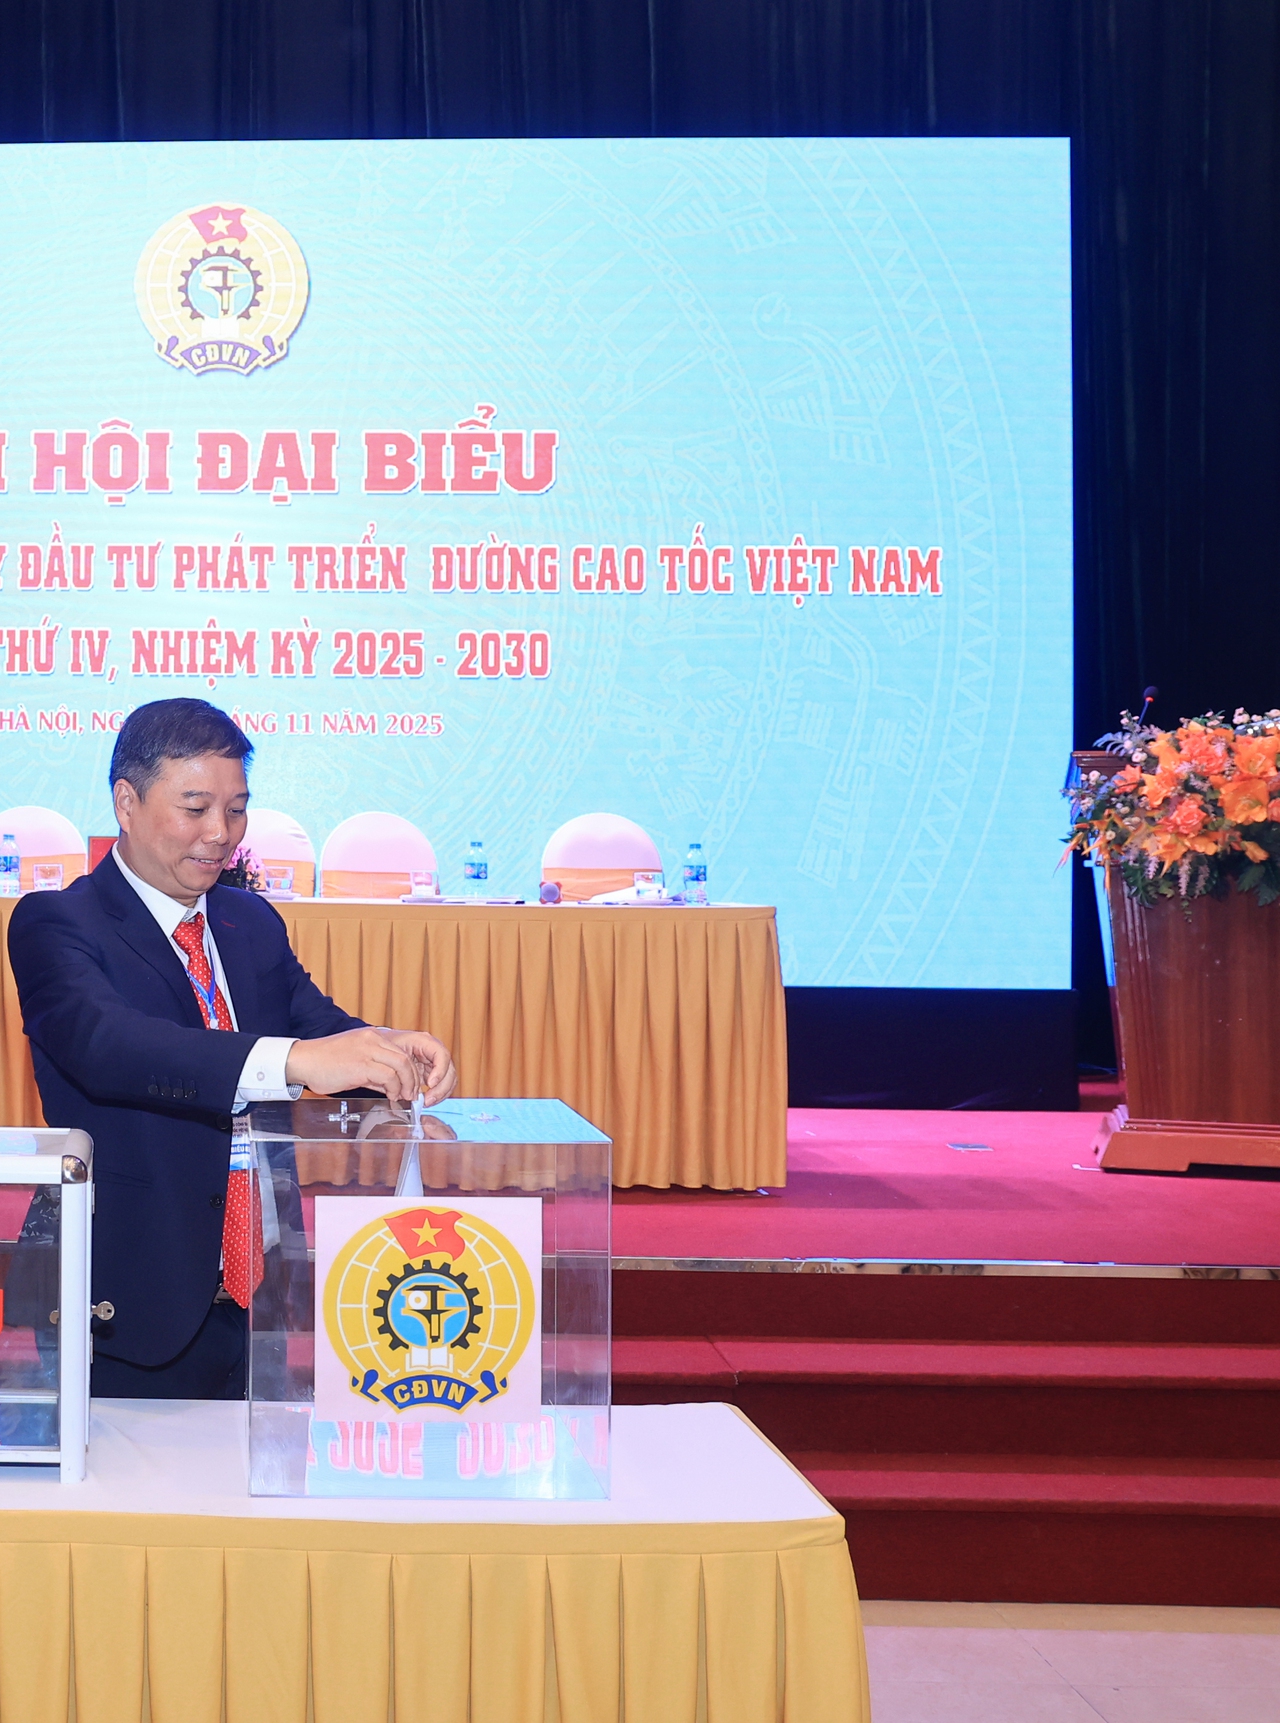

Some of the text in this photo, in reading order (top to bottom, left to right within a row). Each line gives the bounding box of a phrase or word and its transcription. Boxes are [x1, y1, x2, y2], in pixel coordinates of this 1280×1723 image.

[32, 419, 171, 503] HỘI
[197, 431, 337, 503] ĐẠI
[363, 404, 557, 493] BIỂU
[19, 523, 95, 589] ĐẦU
[107, 540, 162, 589] TƯ
[173, 533, 275, 590] PHÁT
[287, 522, 406, 591] TRIỂN
[431, 533, 559, 592] ĐƯỜNG
[572, 547, 645, 592] CAO
[659, 525, 733, 592] TỐC
[745, 536, 836, 606] VIỆT
[851, 548, 941, 594] NAM
[70, 629, 116, 682] IV,
[131, 618, 257, 687] NHIỆM
[270, 617, 321, 675] KỲ
[332, 631, 424, 676] 2025
[456, 632, 549, 677] 2030
[38, 704, 84, 736] NỘI,
[92, 705, 125, 732] NG
[286, 714, 312, 734] 11
[323, 707, 377, 735] NĂM
[386, 714, 444, 735] 2025
[393, 1379, 466, 1404] CĐVN
